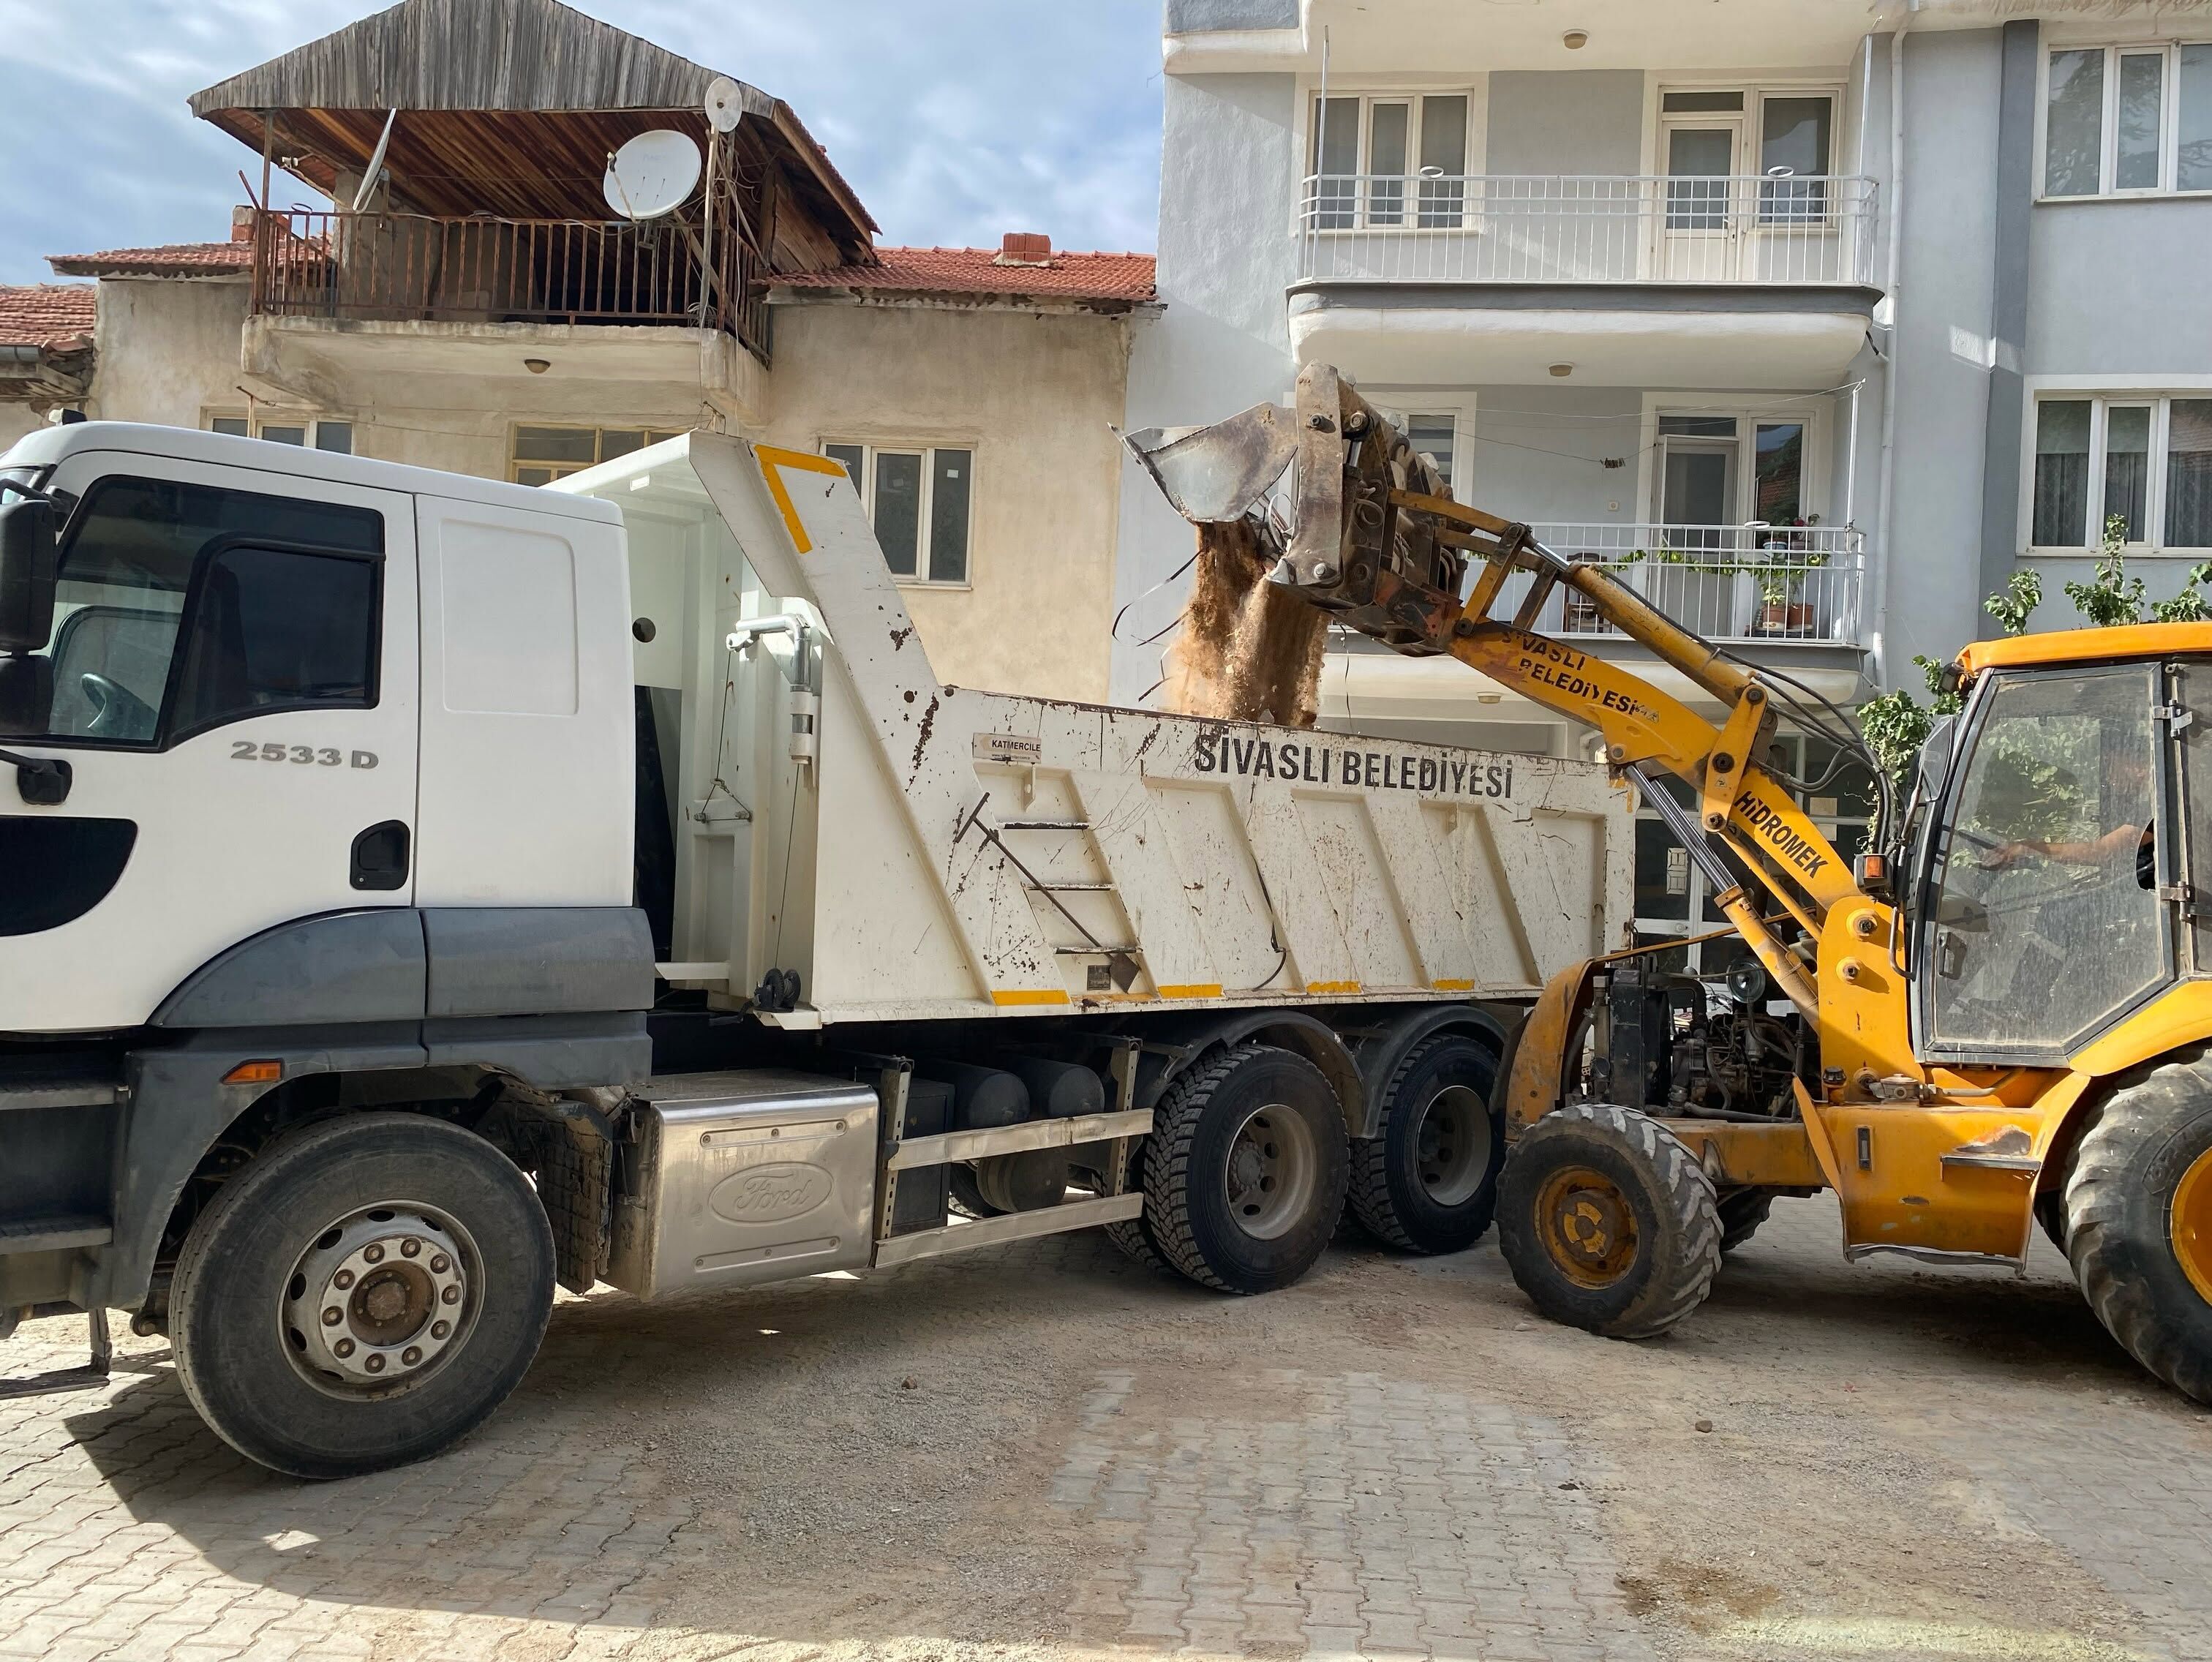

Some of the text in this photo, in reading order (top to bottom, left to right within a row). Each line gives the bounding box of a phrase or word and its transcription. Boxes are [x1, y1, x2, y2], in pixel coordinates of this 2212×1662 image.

[230, 741, 379, 769] 2533 D
[1195, 728, 1513, 799] SİVASLI BELEDİYESİ
[1733, 790, 1829, 879] HİDROMEK
[734, 1170, 813, 1212] Ford
